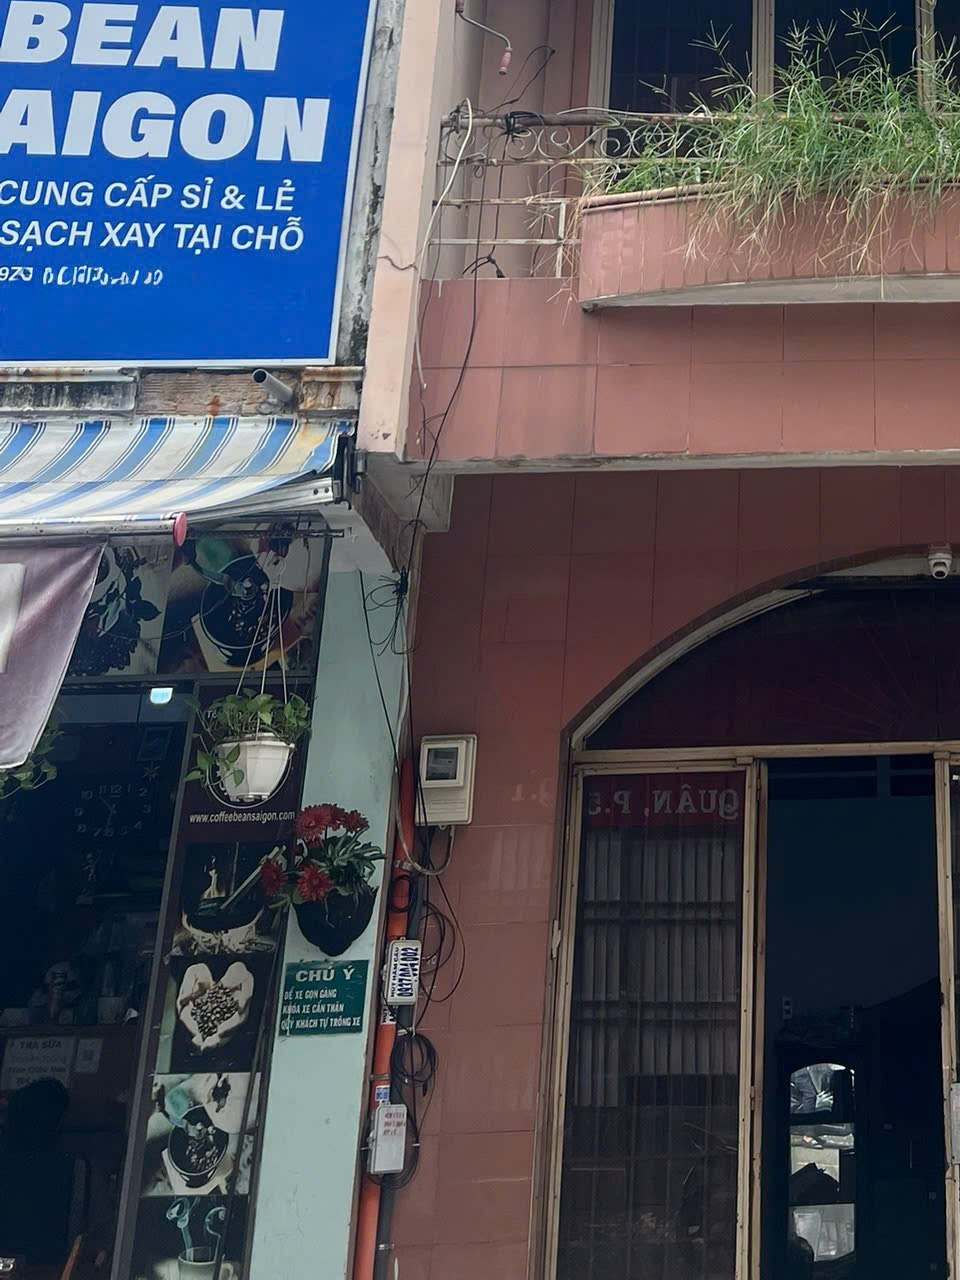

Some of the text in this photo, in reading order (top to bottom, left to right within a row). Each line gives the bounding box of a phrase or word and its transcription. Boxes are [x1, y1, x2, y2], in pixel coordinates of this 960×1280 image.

[0, 0, 284, 71] BEAN
[0, 176, 296, 212] CUNG CẤP SỈ & LẺ
[0, 217, 304, 256] SẠCH XAY TẠI CHỖ
[189, 810, 296, 824] www.coffeebeansaigon.com
[295, 965, 356, 982] CHÚ Ý
[295, 990, 303, 1000] XE
[304, 989, 318, 1001] GỌN
[320, 987, 337, 999] GÀNG
[302, 1004, 310, 1013] XE
[295, 1017, 318, 1029] KHÁCH
[352, 1016, 361, 1026] XE
